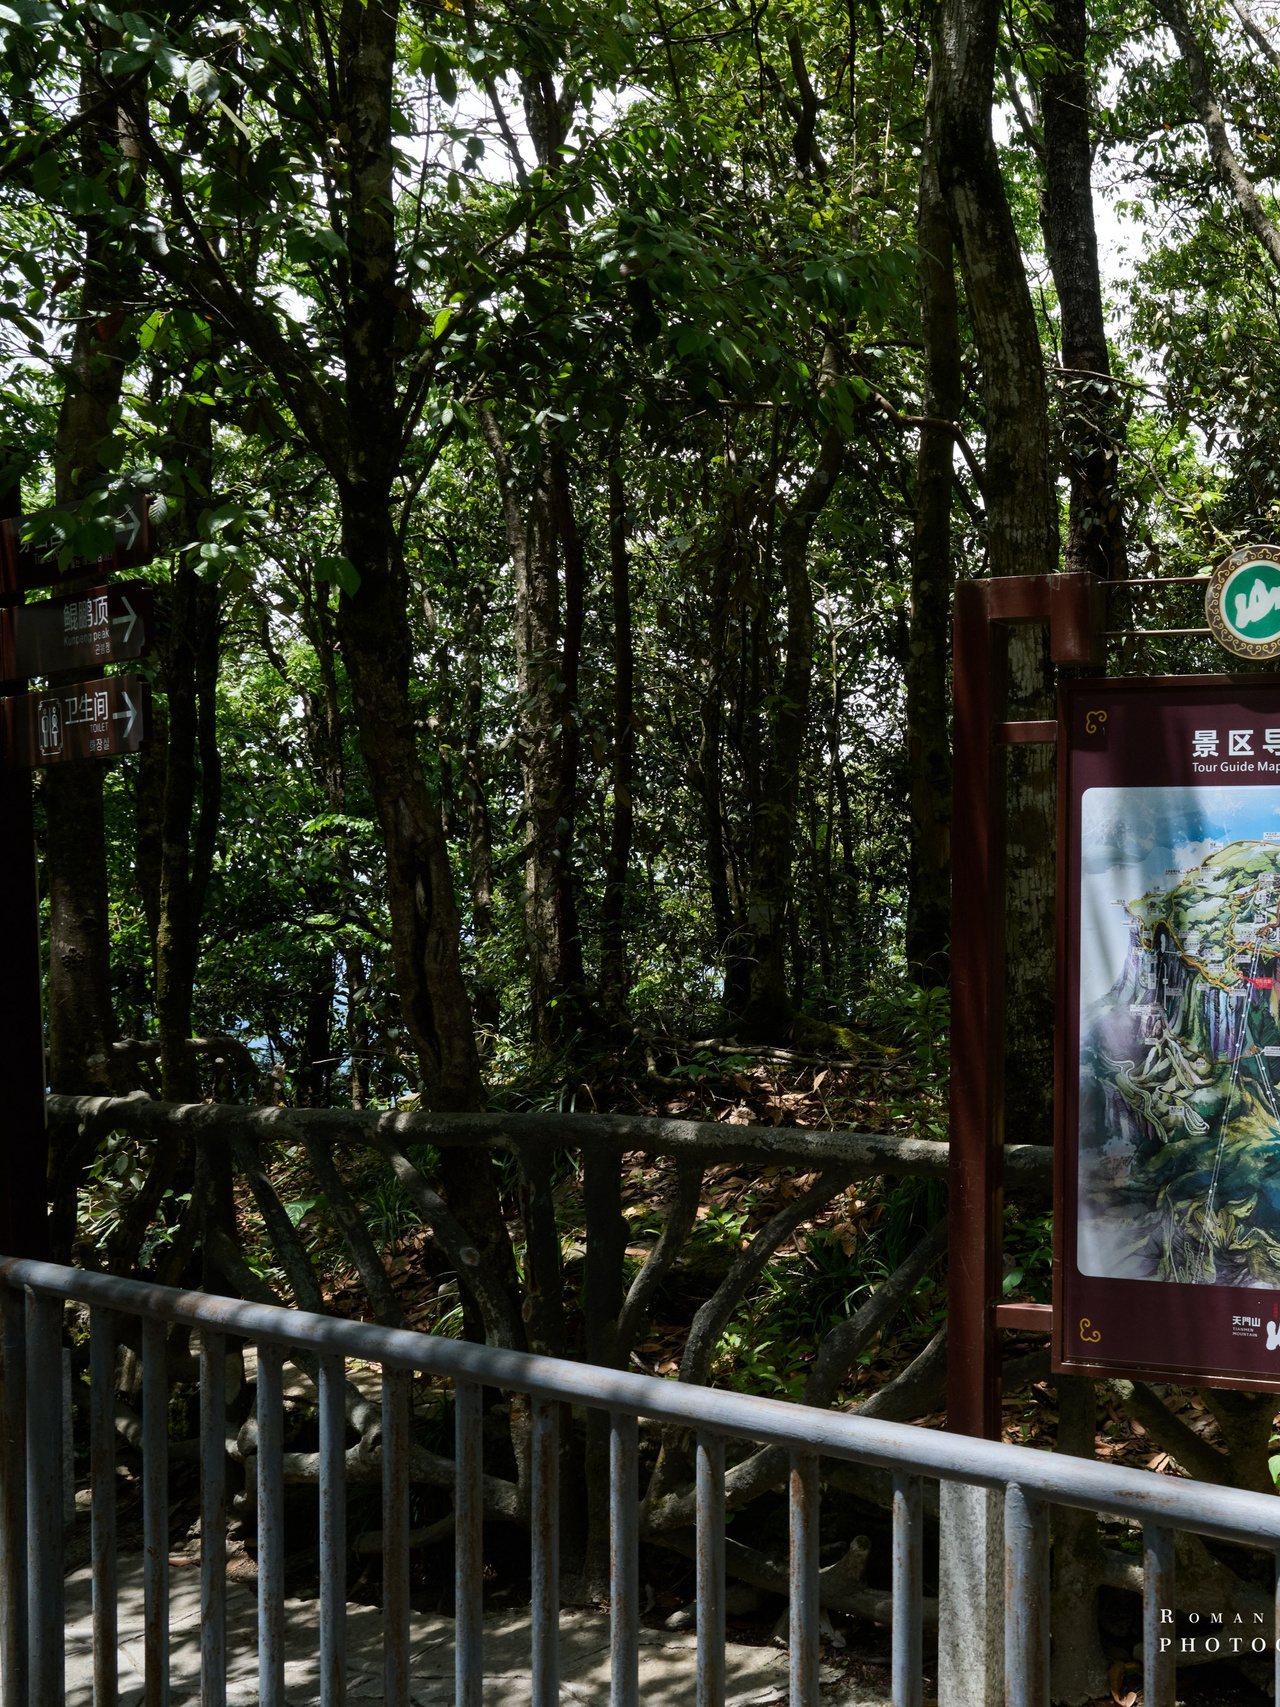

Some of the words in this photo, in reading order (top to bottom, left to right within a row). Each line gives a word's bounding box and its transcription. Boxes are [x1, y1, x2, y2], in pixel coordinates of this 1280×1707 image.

[63, 595, 110, 632] 鲲鹏顶
[63, 633, 92, 647] Kunpeng
[93, 627, 110, 642] peak
[64, 691, 109, 725] 卫生间
[89, 721, 109, 734] TOILET
[89, 737, 110, 752] 화장실
[1192, 762, 1218, 773] Tour
[1220, 761, 1255, 772] Guide
[1232, 1315, 1261, 1327] 天門山
